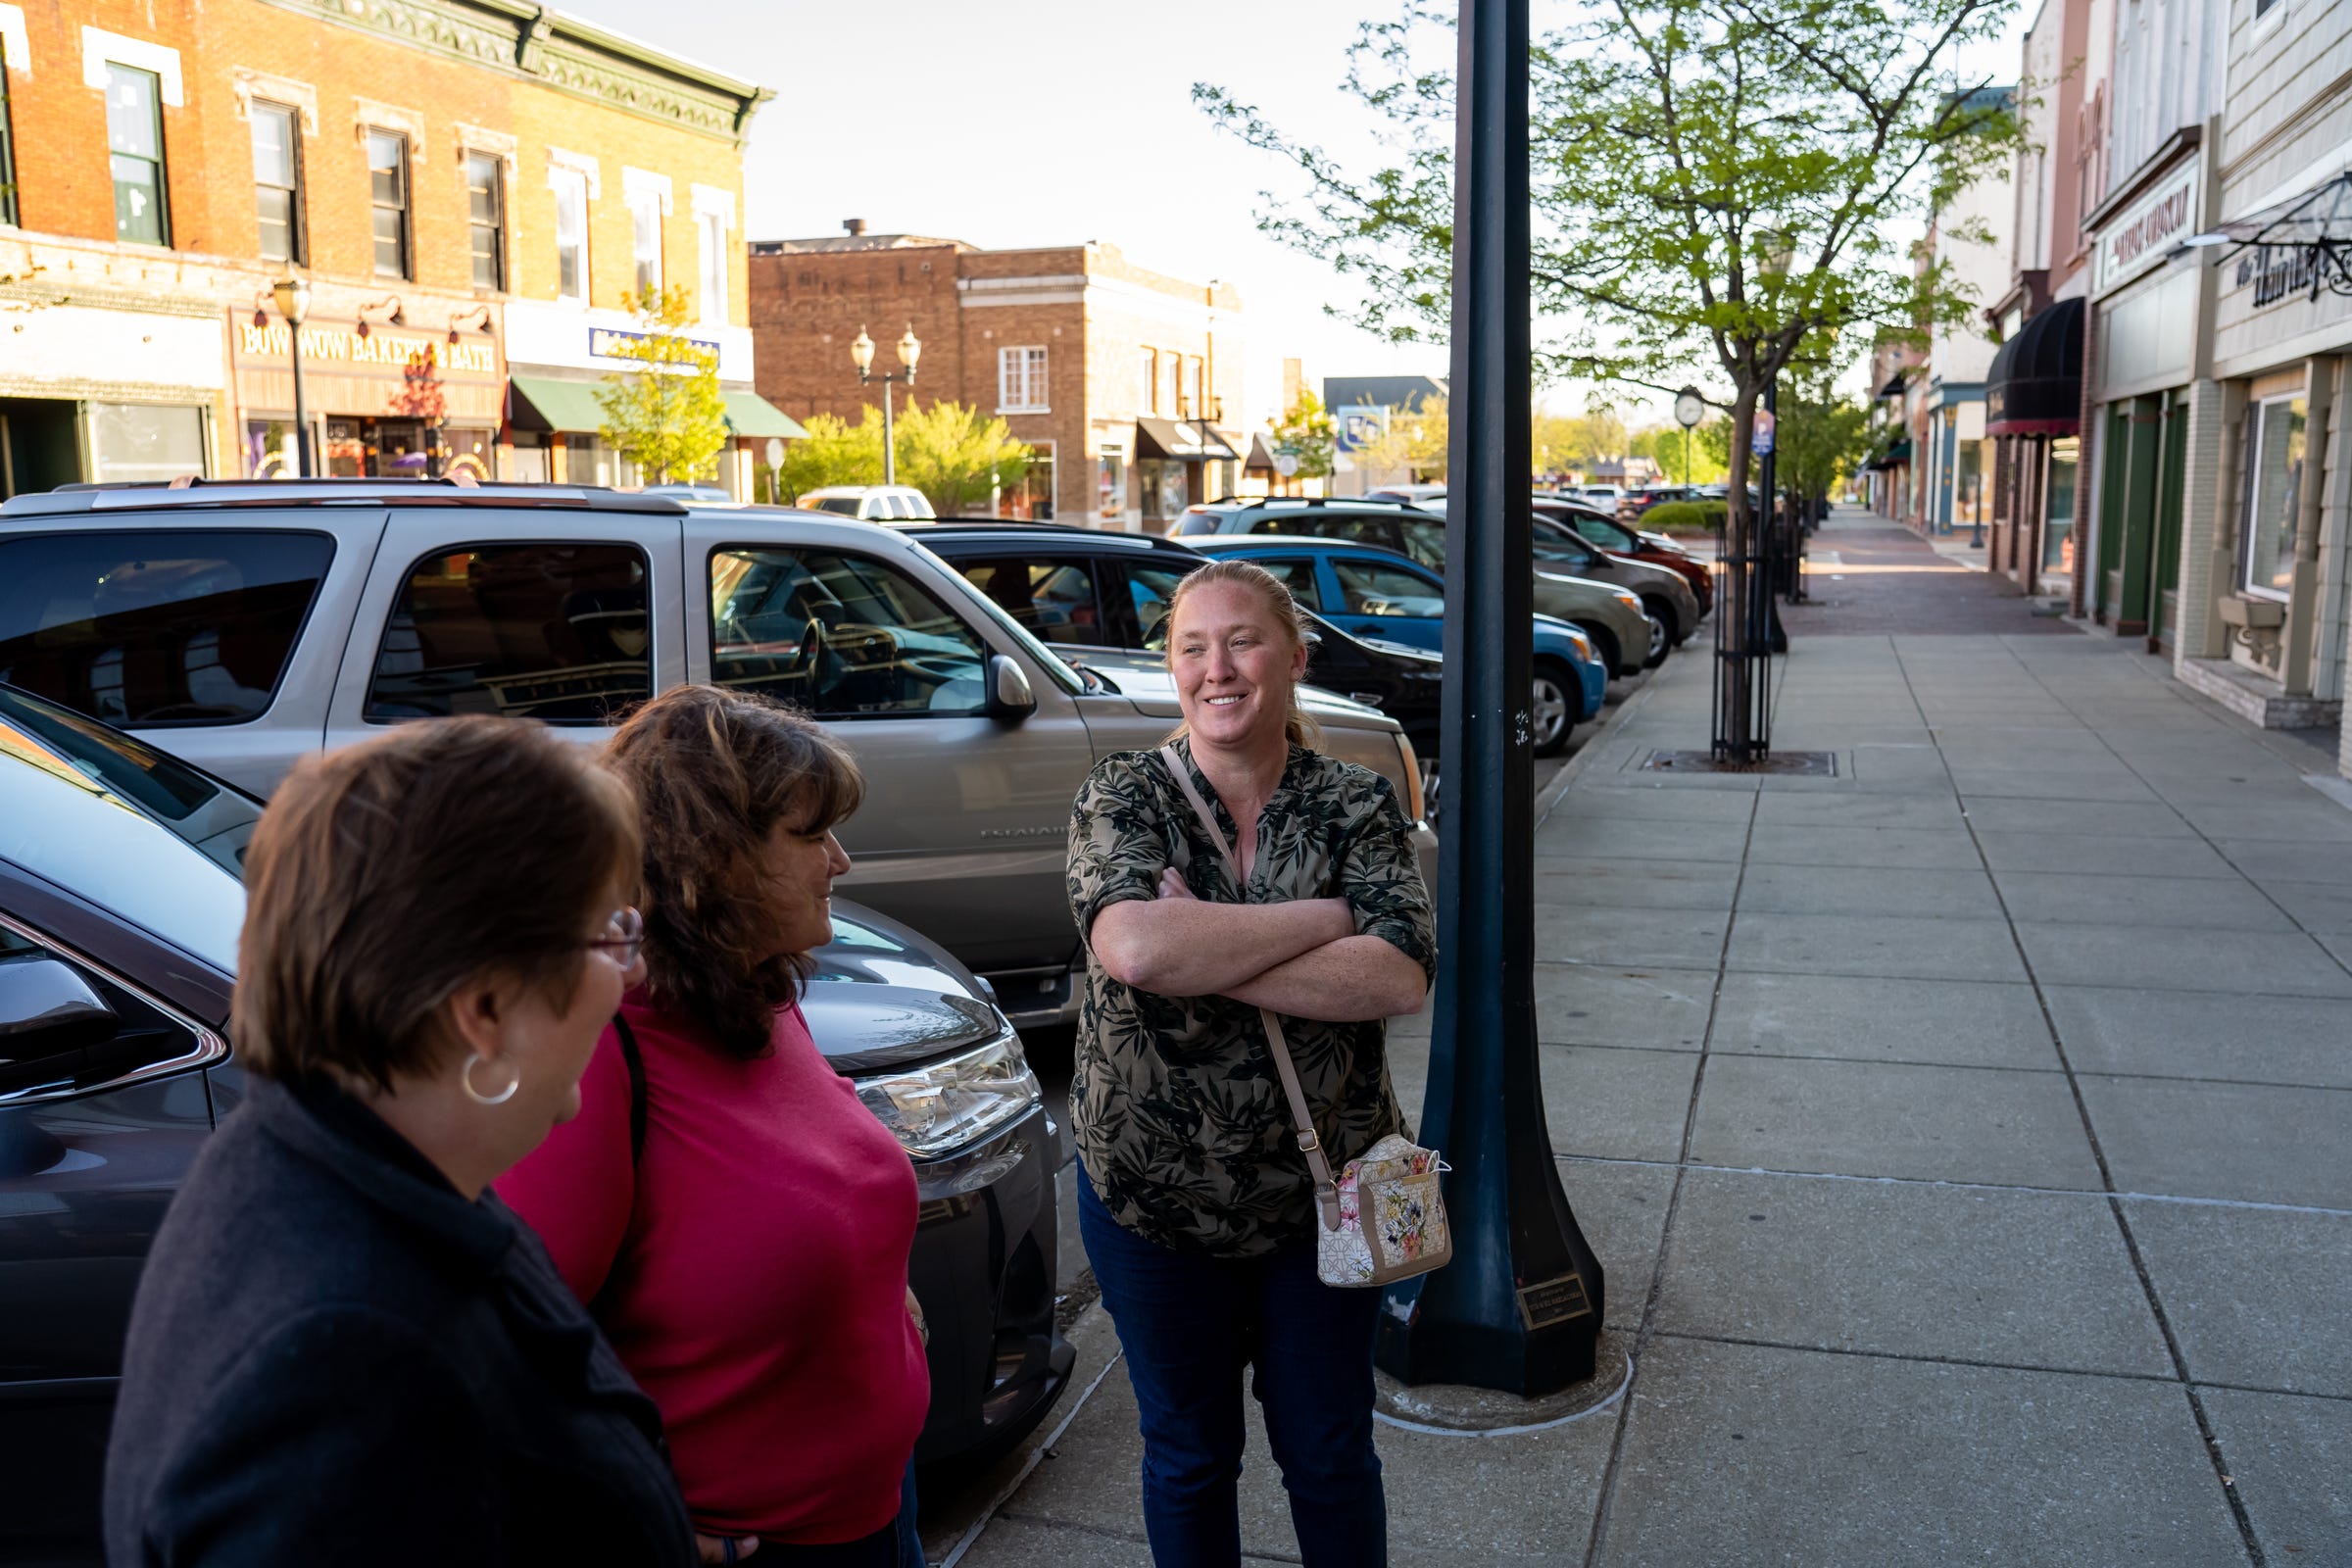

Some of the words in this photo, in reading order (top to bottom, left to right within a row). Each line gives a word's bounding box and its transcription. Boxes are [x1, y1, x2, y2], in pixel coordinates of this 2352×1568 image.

[241, 323, 291, 355] BOW
[298, 328, 346, 360] WOW
[450, 342, 495, 372] BATH
